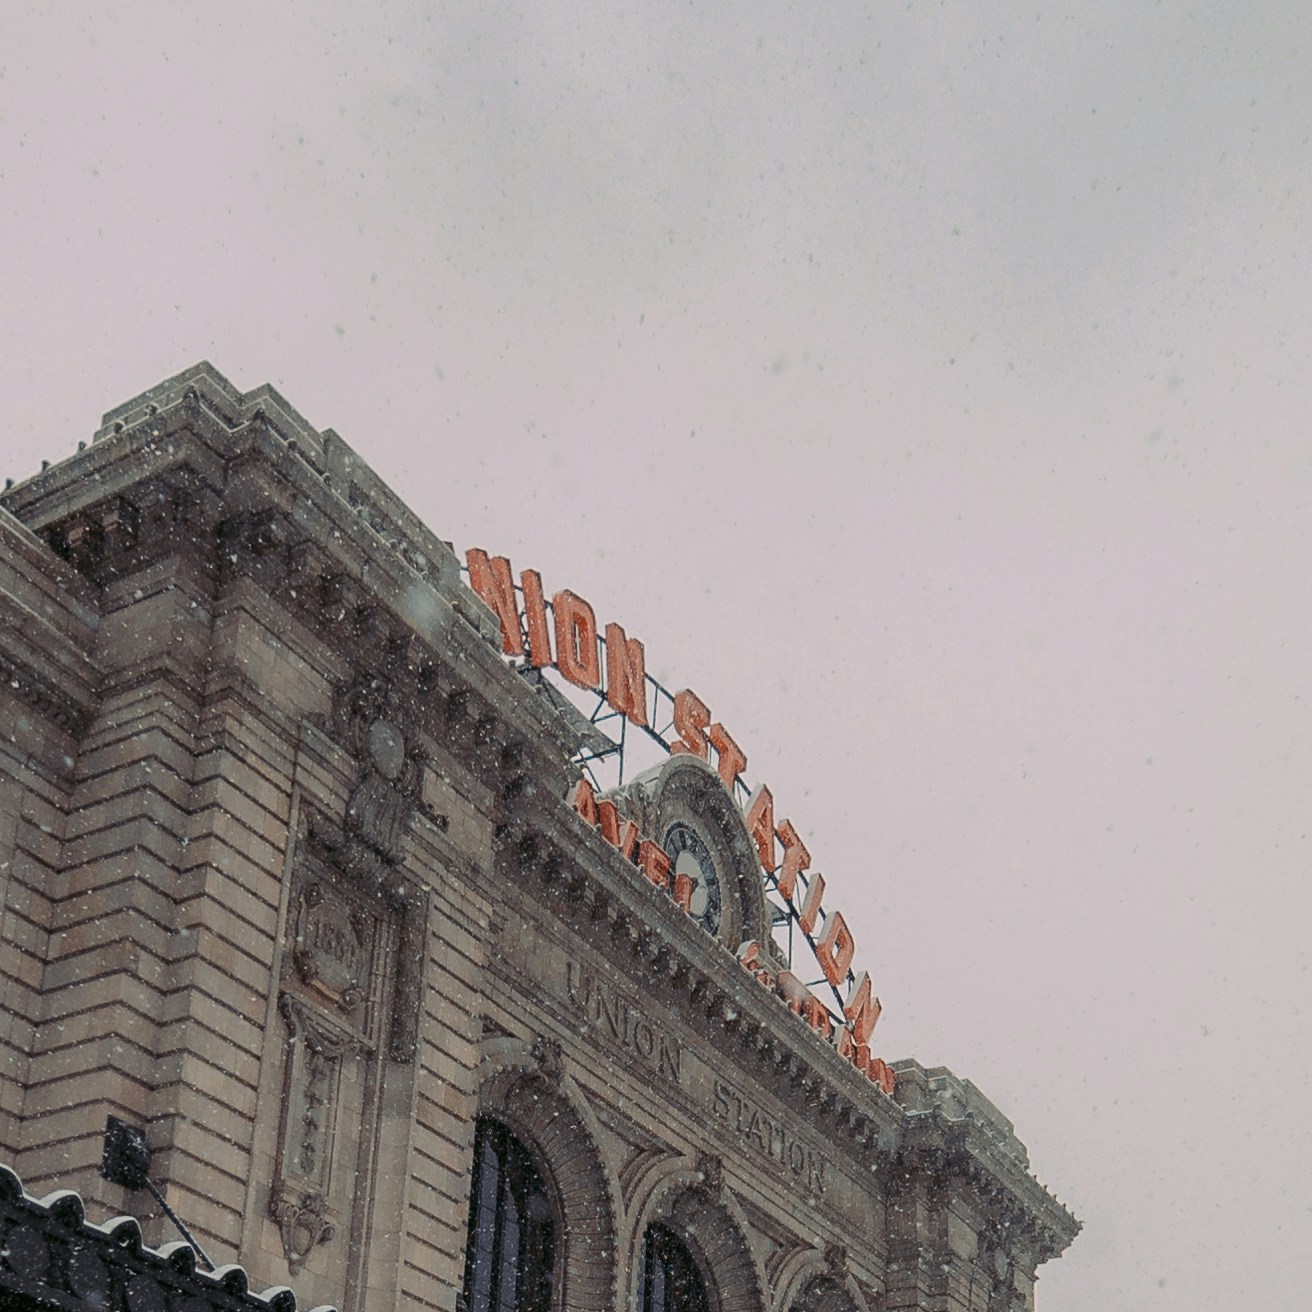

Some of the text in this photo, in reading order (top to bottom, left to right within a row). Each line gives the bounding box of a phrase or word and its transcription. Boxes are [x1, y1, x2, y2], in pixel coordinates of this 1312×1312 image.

[445, 541, 883, 1048] NION STATION
[566, 961, 826, 1194] UNION STATION
